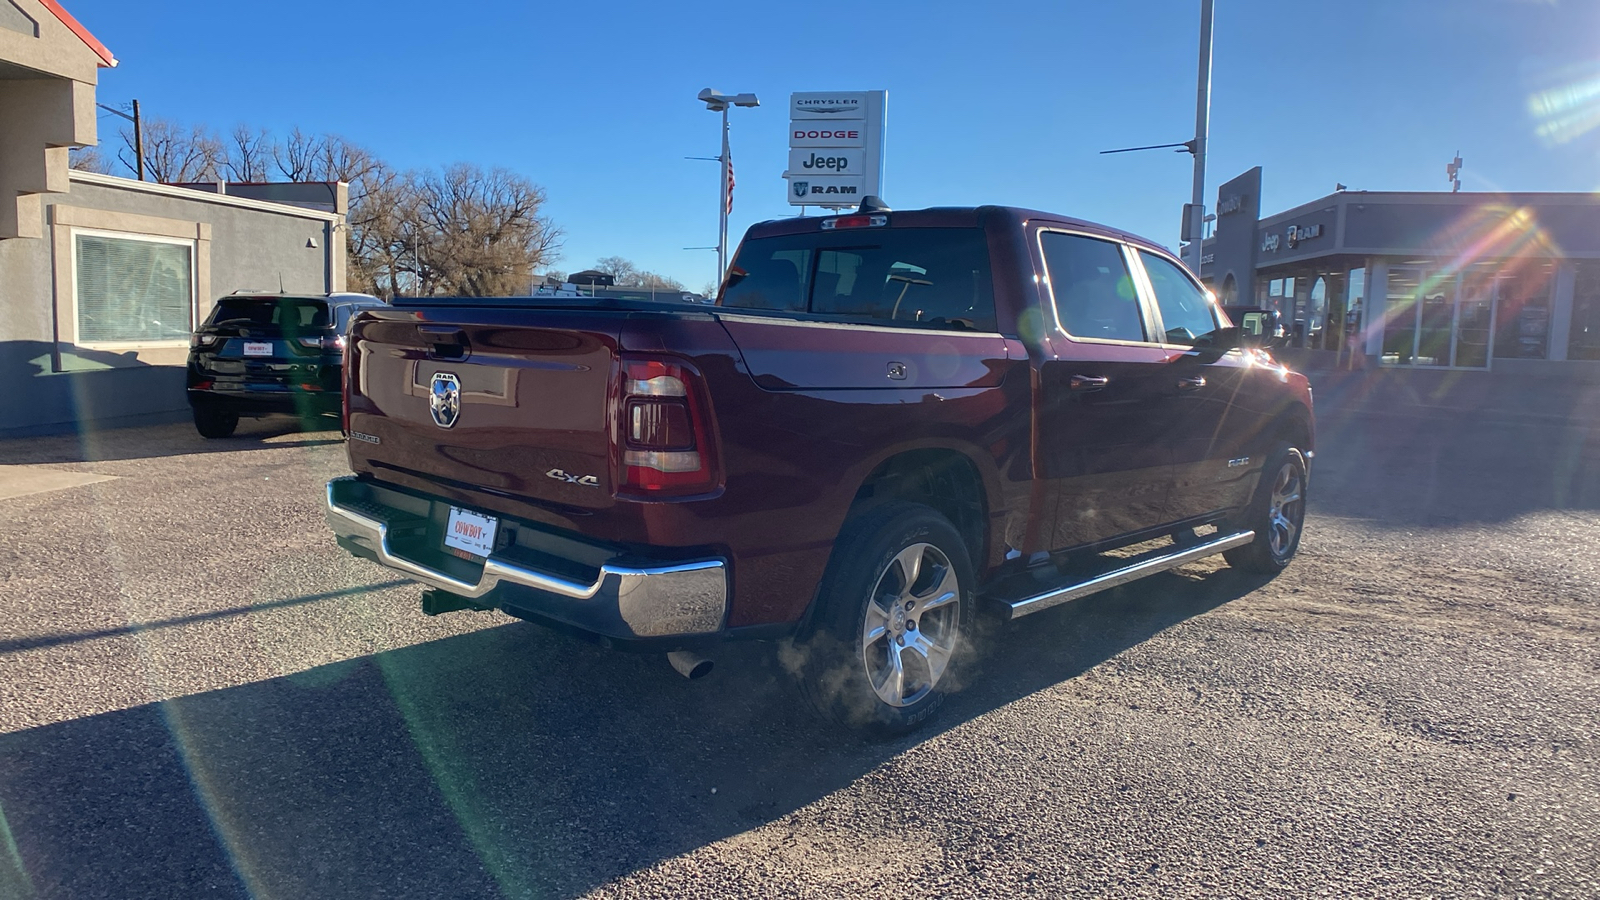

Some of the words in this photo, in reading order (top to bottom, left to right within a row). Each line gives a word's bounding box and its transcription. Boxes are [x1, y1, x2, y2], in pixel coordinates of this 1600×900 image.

[794, 131, 858, 139] DODGE
[803, 153, 848, 172] Jeep
[811, 186, 857, 194] RAM
[1297, 224, 1319, 241] RAM
[455, 520, 482, 540] COWBOY
